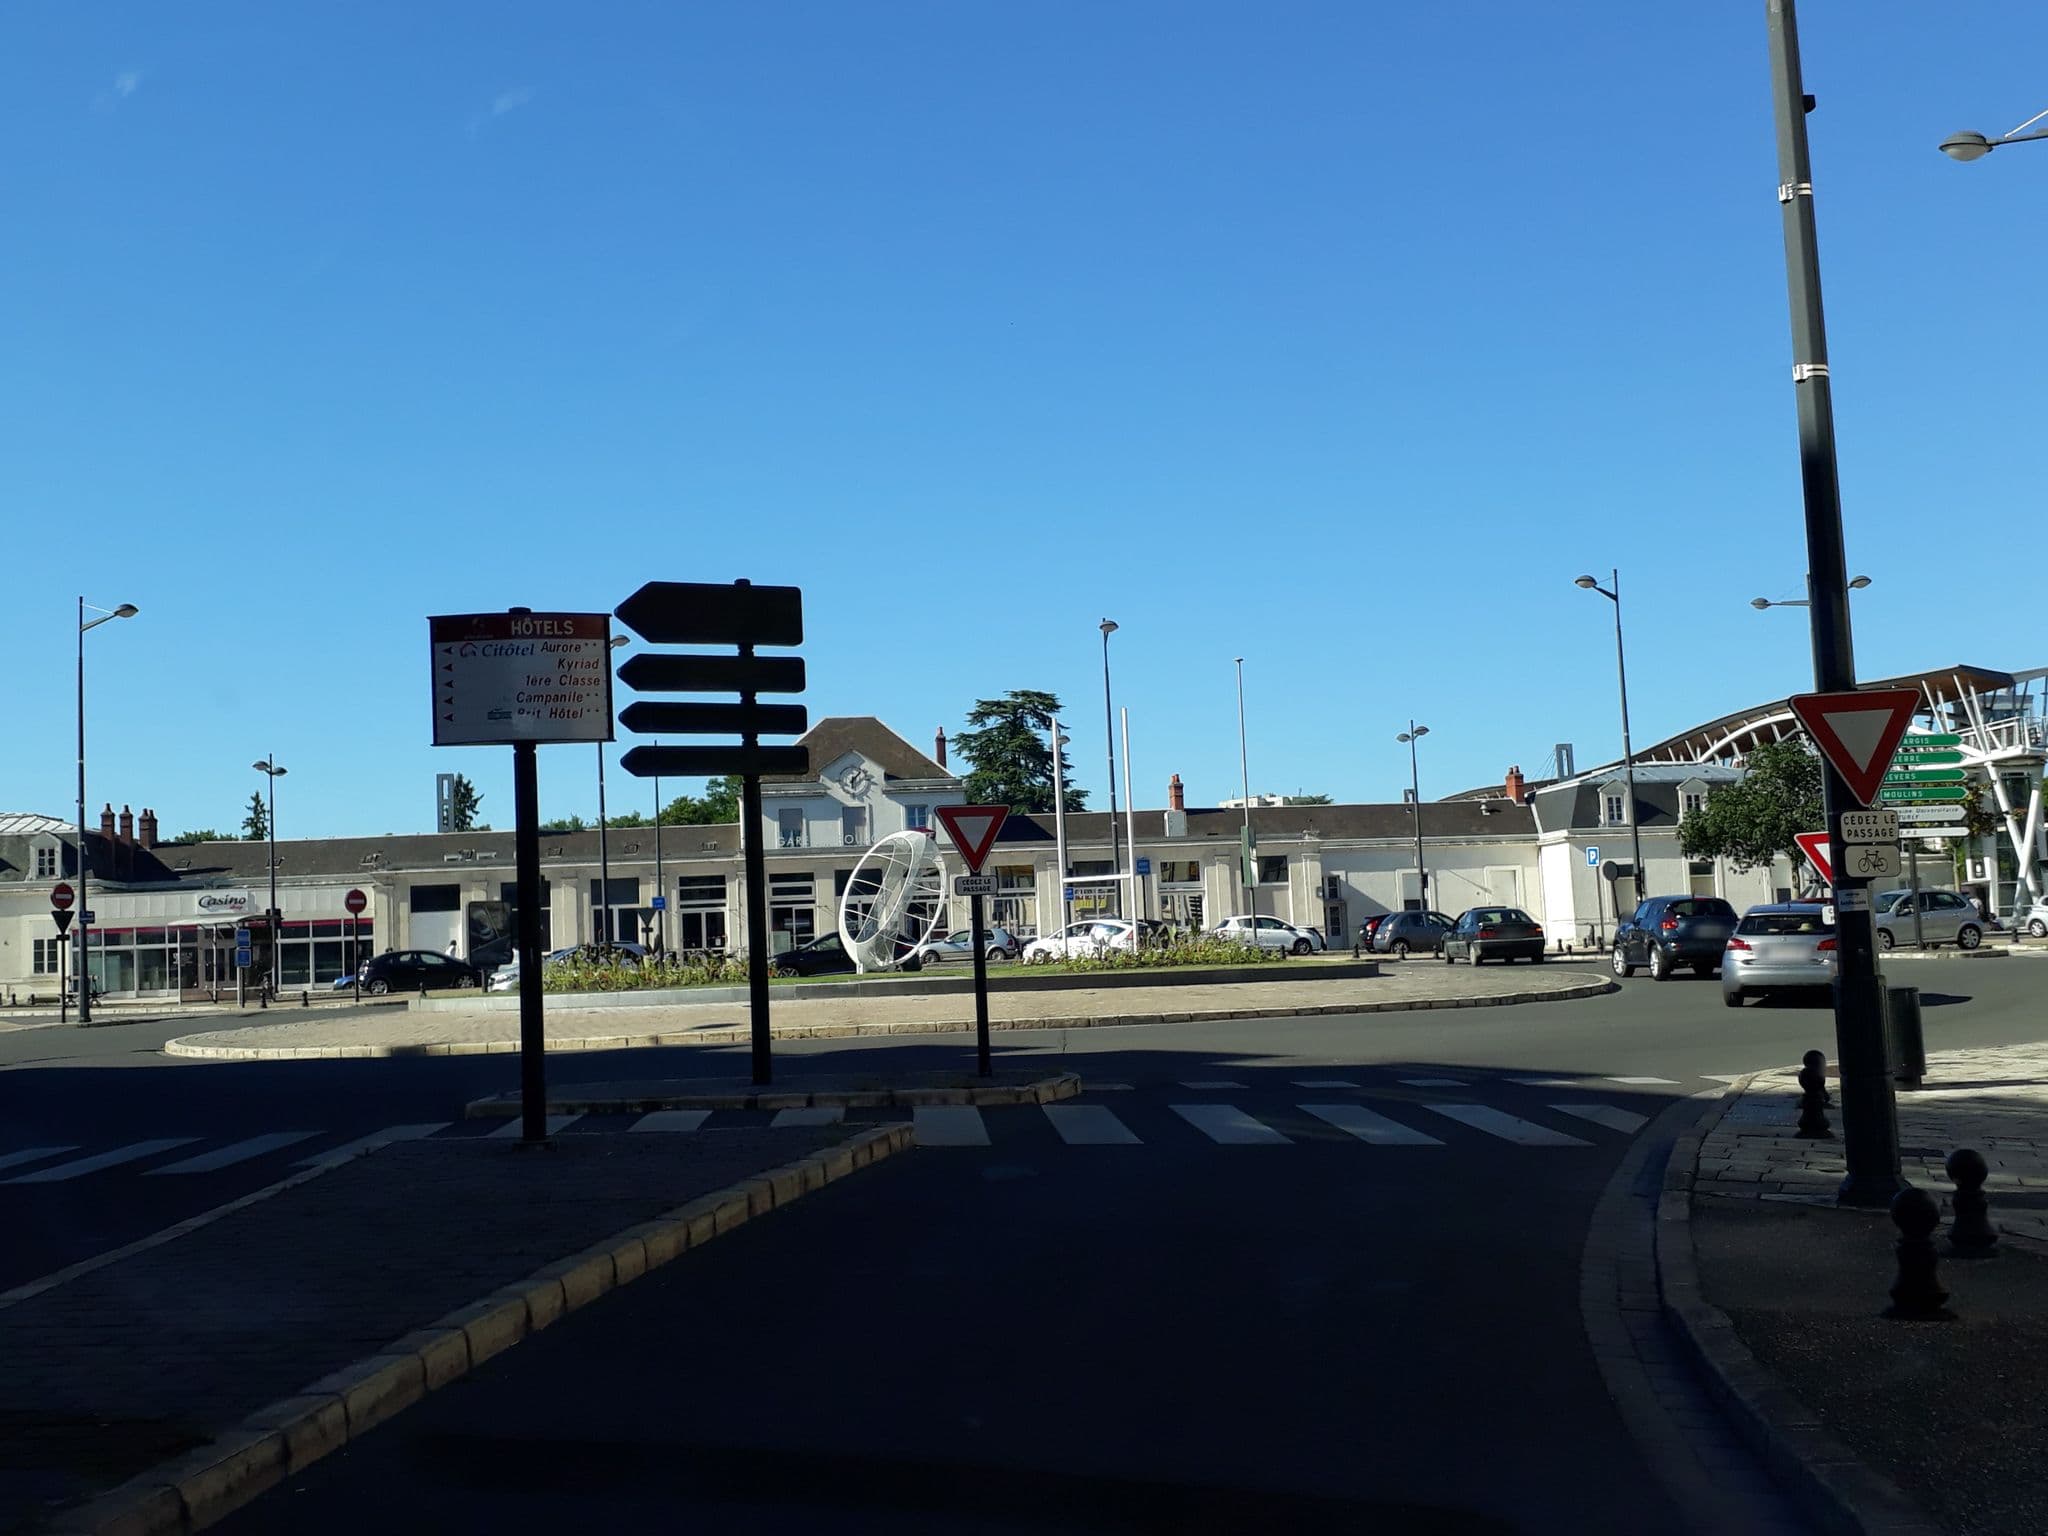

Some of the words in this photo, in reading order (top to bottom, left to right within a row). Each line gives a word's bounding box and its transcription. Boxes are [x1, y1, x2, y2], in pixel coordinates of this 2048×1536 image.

[511, 617, 574, 636] HÔTELS
[482, 643, 535, 657] Citôtel
[540, 641, 582, 653] Aurore
[557, 658, 600, 672] Kyriad
[559, 674, 601, 686] Classe
[516, 691, 584, 706] Campanile
[549, 707, 584, 720] Hôtel
[1903, 737, 1930, 745] ARGIS
[1885, 773, 1917, 781] EVERS
[1883, 790, 1923, 798] MOULINS
[1884, 815, 1896, 824] LE
[1847, 828, 1894, 838] PASSAGE
[198, 894, 247, 908] Casino
